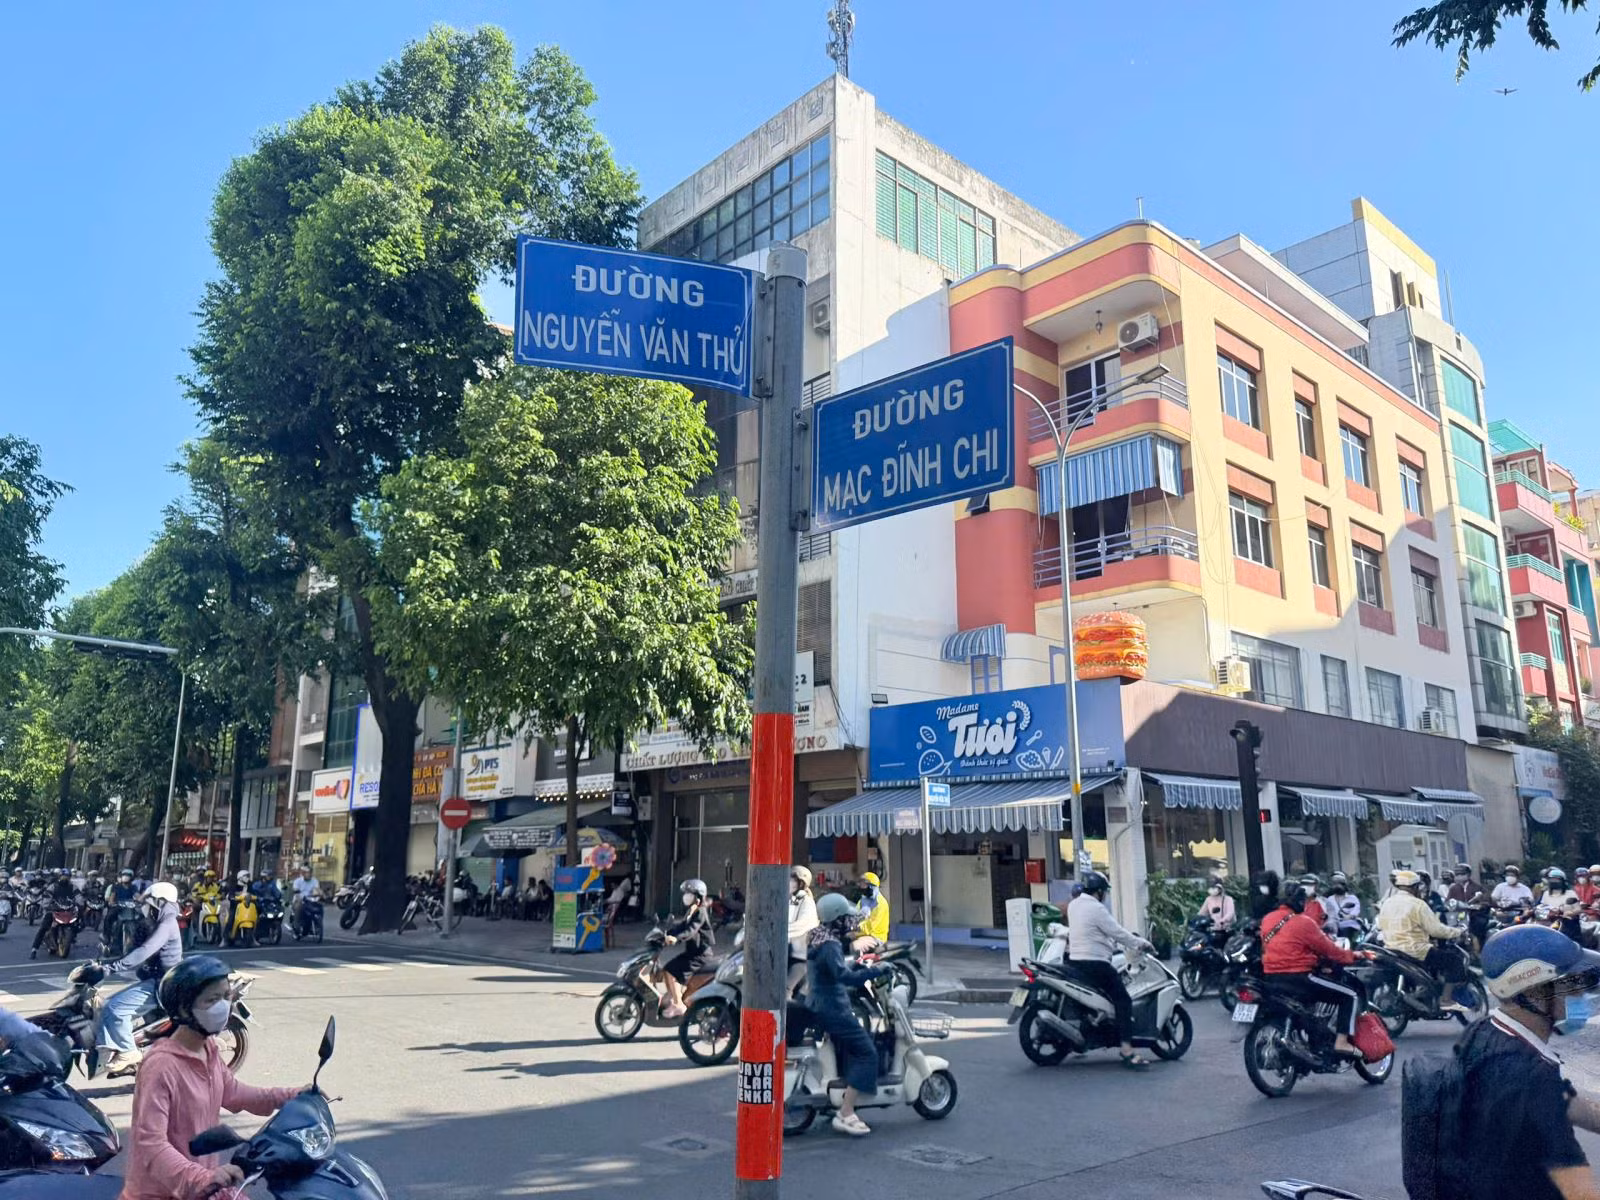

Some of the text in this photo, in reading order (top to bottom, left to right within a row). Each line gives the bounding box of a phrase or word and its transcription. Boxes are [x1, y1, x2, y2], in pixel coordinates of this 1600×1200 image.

[571, 265, 704, 307] ĐƯỜNG
[524, 308, 744, 375] NGUYỄN VĂN THỦ
[852, 379, 964, 439] ĐƯỜNG
[824, 428, 998, 515] MẠC ĐĨNH CHI
[936, 703, 979, 720] Madame
[948, 711, 1017, 758] Tươi
